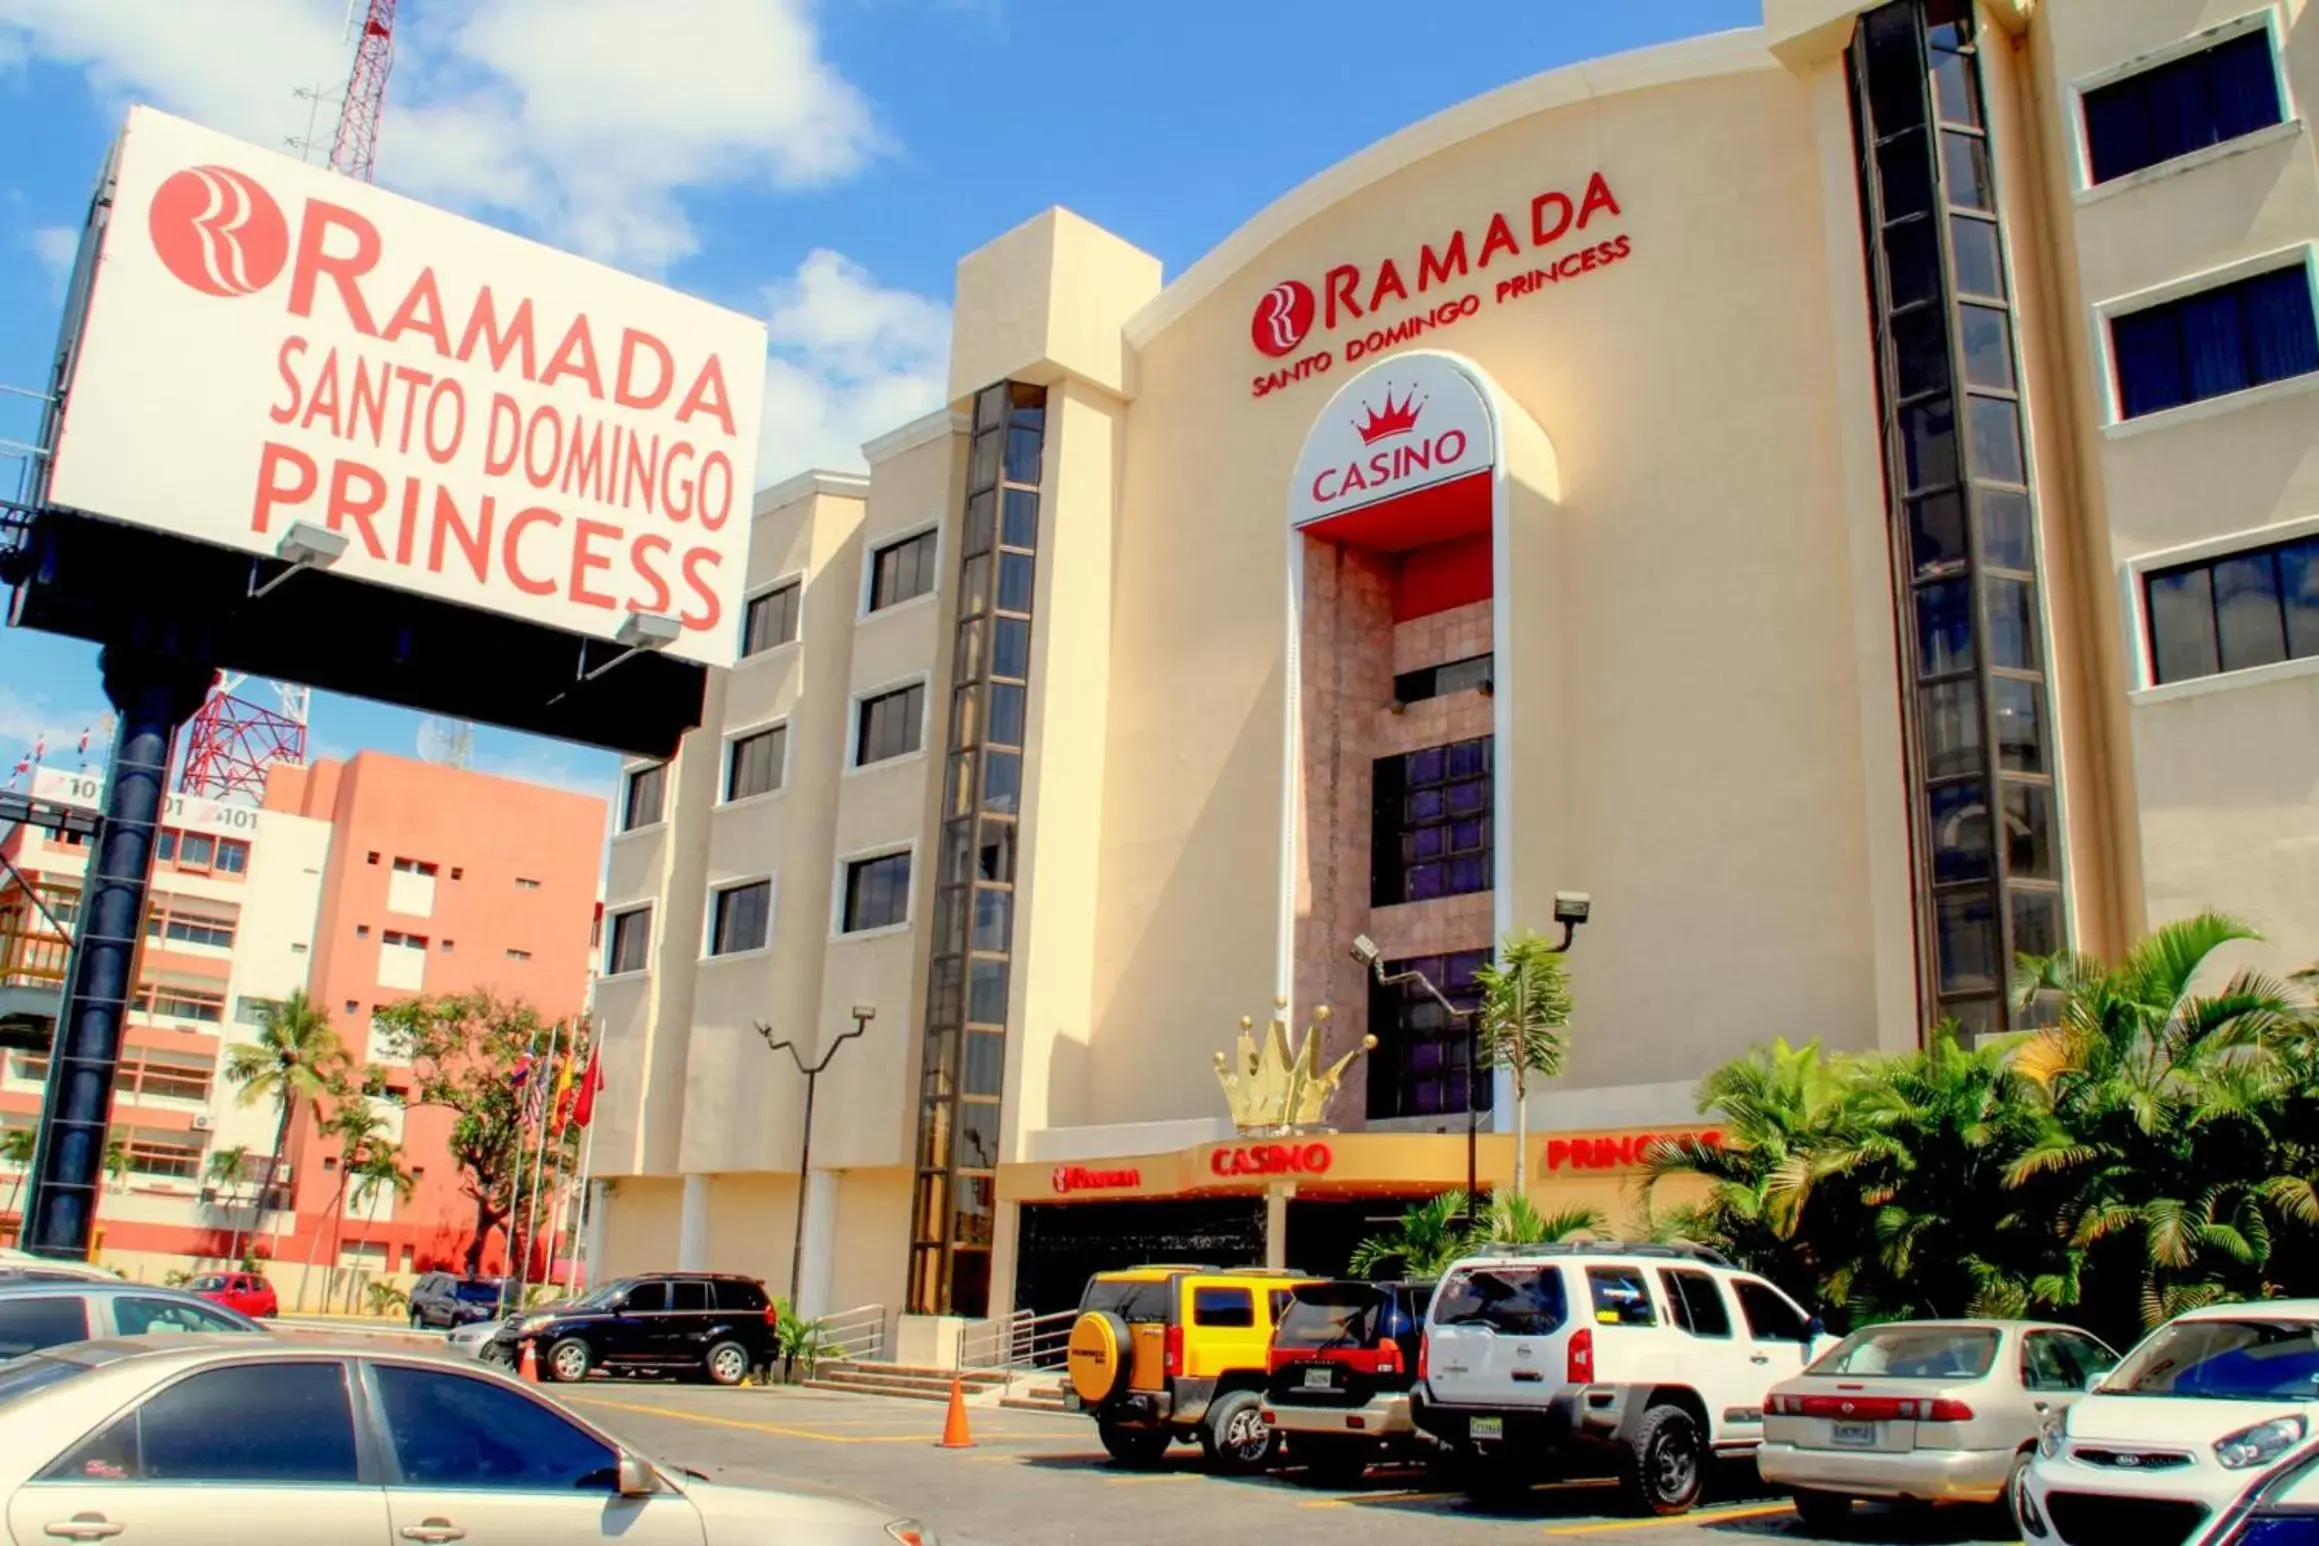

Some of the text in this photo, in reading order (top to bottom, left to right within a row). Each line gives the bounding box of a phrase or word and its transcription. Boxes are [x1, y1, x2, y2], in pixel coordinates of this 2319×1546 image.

[288, 197, 737, 437] RAMADA
[1252, 235, 1631, 398] SANTO DOMINGO PRINCESS
[1322, 171, 1621, 331] RAMADA
[270, 335, 733, 532] SANTO DOMINGO
[1311, 428, 1468, 504] CASINO
[251, 440, 723, 633] PRINCESS
[70, 778, 103, 800] 10
[1211, 1142, 1333, 1176] CASINO
